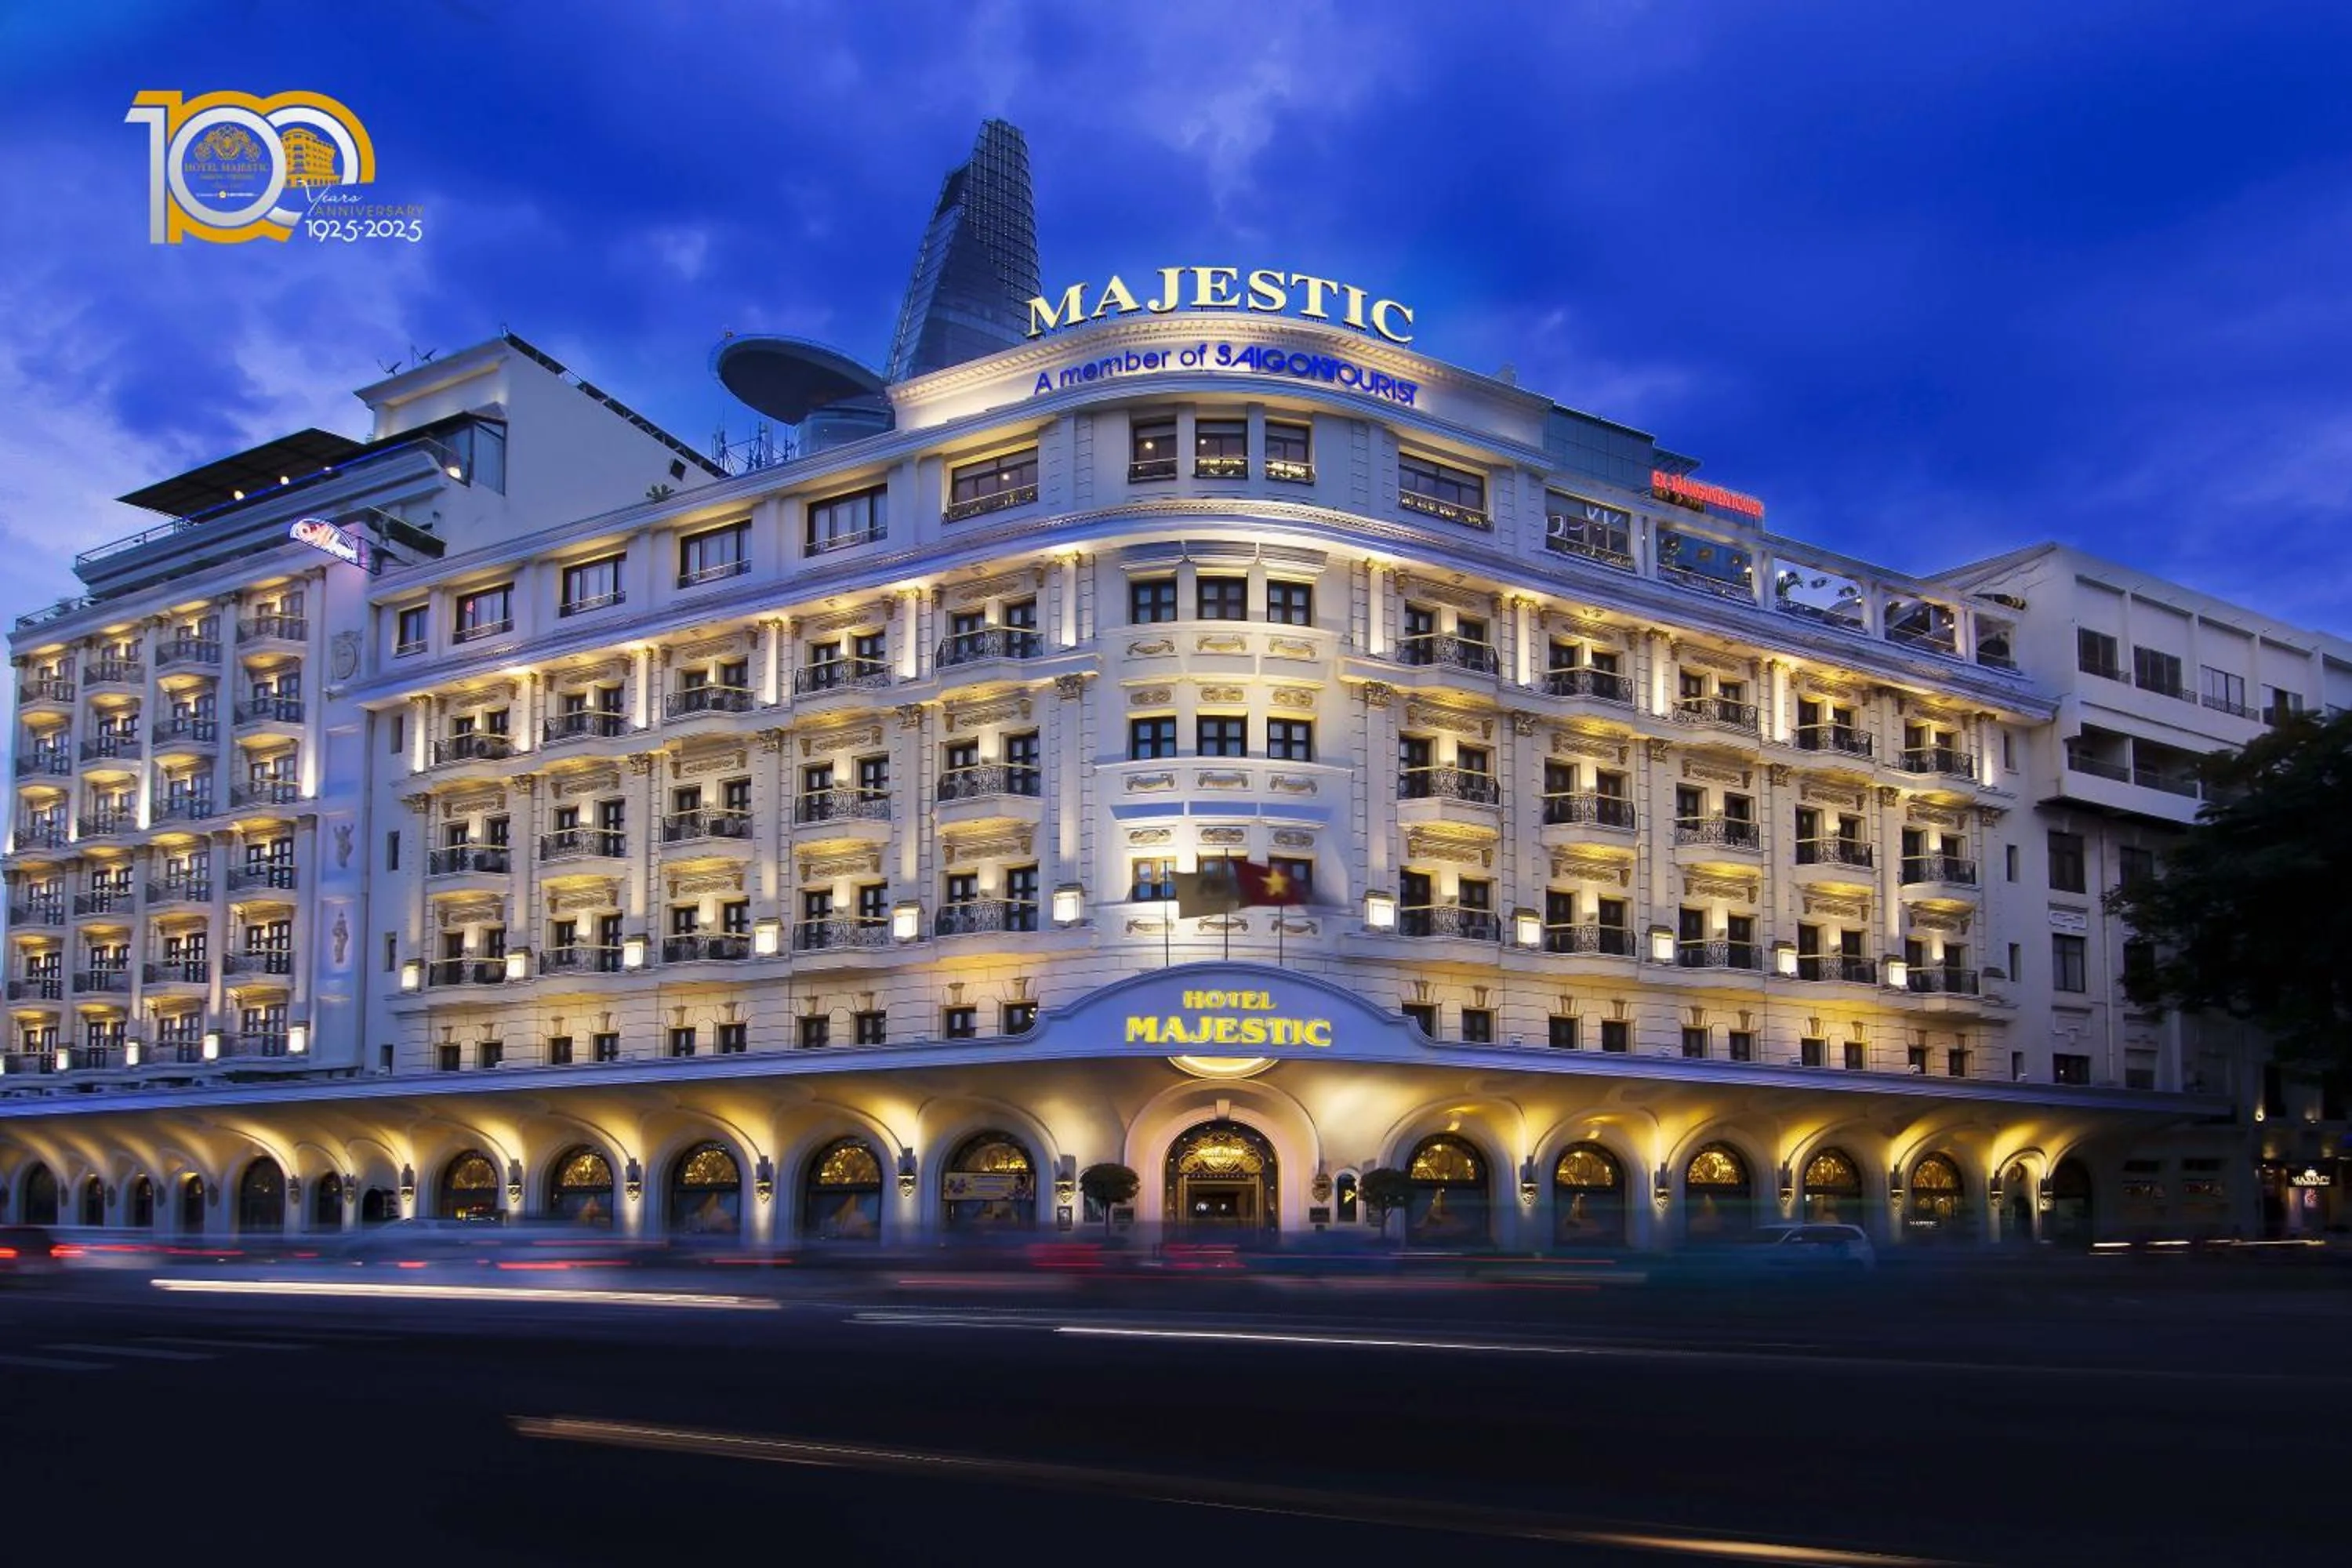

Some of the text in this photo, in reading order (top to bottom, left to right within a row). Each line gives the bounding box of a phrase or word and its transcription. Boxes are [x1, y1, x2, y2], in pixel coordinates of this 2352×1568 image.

[1024, 267, 1415, 343] MAJESTIC
[1033, 340, 1419, 405] A member of SAIGONTOURIST
[1183, 989, 1277, 1010] HOTEL
[1125, 1014, 1332, 1047] MAJESTIC
